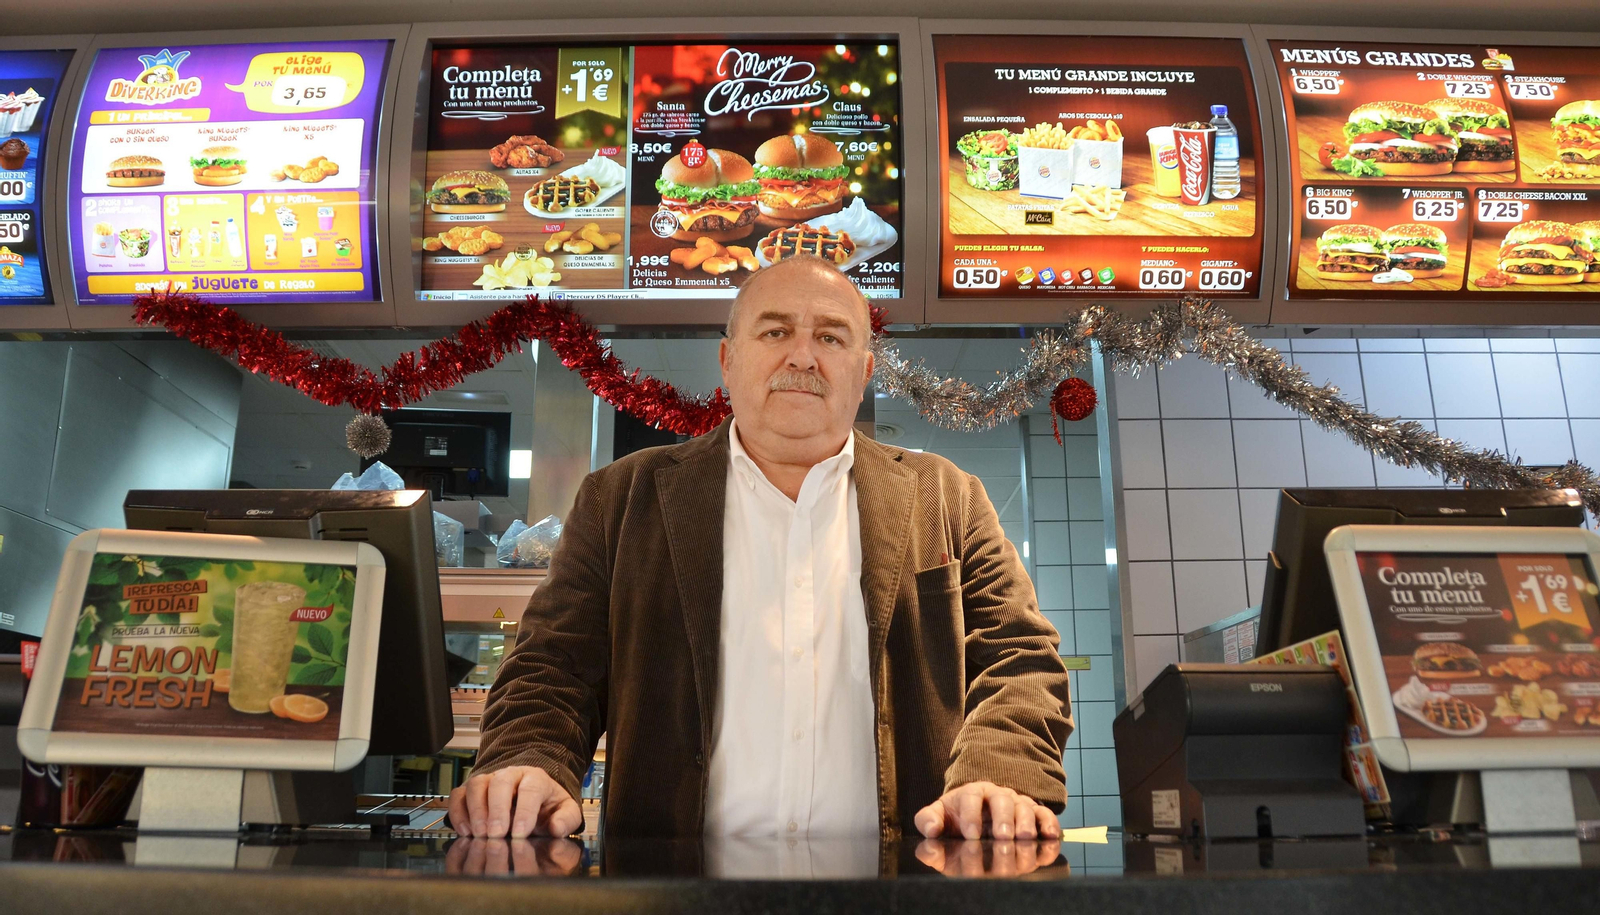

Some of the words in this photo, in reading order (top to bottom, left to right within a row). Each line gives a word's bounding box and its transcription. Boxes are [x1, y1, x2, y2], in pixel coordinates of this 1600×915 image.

[1280, 48, 1361, 65] MENÚS
[1365, 51, 1475, 68] GRANDES
[273, 66, 288, 74] TU
[717, 48, 794, 87] Merry
[1290, 68, 1298, 76] 1
[443, 65, 542, 87] Completa
[995, 69, 1015, 80] TU
[1019, 68, 1061, 81] MENÚ
[1065, 70, 1128, 82] GRANDE
[1131, 71, 1195, 83] INCLUYE
[1417, 73, 1425, 81] 2
[449, 84, 470, 100] tu
[475, 82, 533, 99] menú
[1296, 78, 1336, 92] 6,50
[1446, 83, 1486, 96] 7,25
[1510, 85, 1551, 98] 7,50
[284, 86, 326, 106] 3,65
[704, 79, 823, 116] Cheesemas
[503, 99, 538, 107] productos
[656, 101, 685, 111] Santa
[833, 102, 862, 112] Claus
[629, 143, 672, 155] 8,50€
[683, 148, 703, 156] 175
[834, 142, 878, 154] 7,60€
[688, 157, 702, 166] gr.
[1306, 187, 1314, 197] 6
[1402, 189, 1410, 198] 7
[1478, 190, 1486, 200] 8
[85, 198, 97, 216] 2
[1308, 200, 1347, 218] 6,50
[1415, 202, 1454, 219] 6,25
[1481, 202, 1518, 220] 7,25
[626, 255, 669, 268] 1,99€
[632, 269, 667, 277] Delicias
[862, 274, 895, 283] caliente
[956, 269, 998, 287] 0,50
[1142, 270, 1183, 288] 0,60
[1201, 271, 1242, 288] 0,60
[645, 278, 672, 287] Queso
[674, 278, 717, 286] Emmental
[1378, 566, 1487, 590] Completa
[128, 582, 200, 597] ¡REFRESCA
[1391, 587, 1416, 604] tu
[1420, 586, 1484, 604] menú
[134, 598, 154, 612] TU
[159, 595, 193, 610] DÍA!
[1456, 606, 1492, 614] productos
[296, 610, 326, 619] NUEVO
[112, 627, 149, 636] PRUEBA
[154, 627, 165, 635] LA
[169, 626, 199, 634] NUEVA
[88, 644, 218, 675] LEMON
[80, 675, 214, 708] FRESH
[1251, 683, 1282, 692] EPSON
